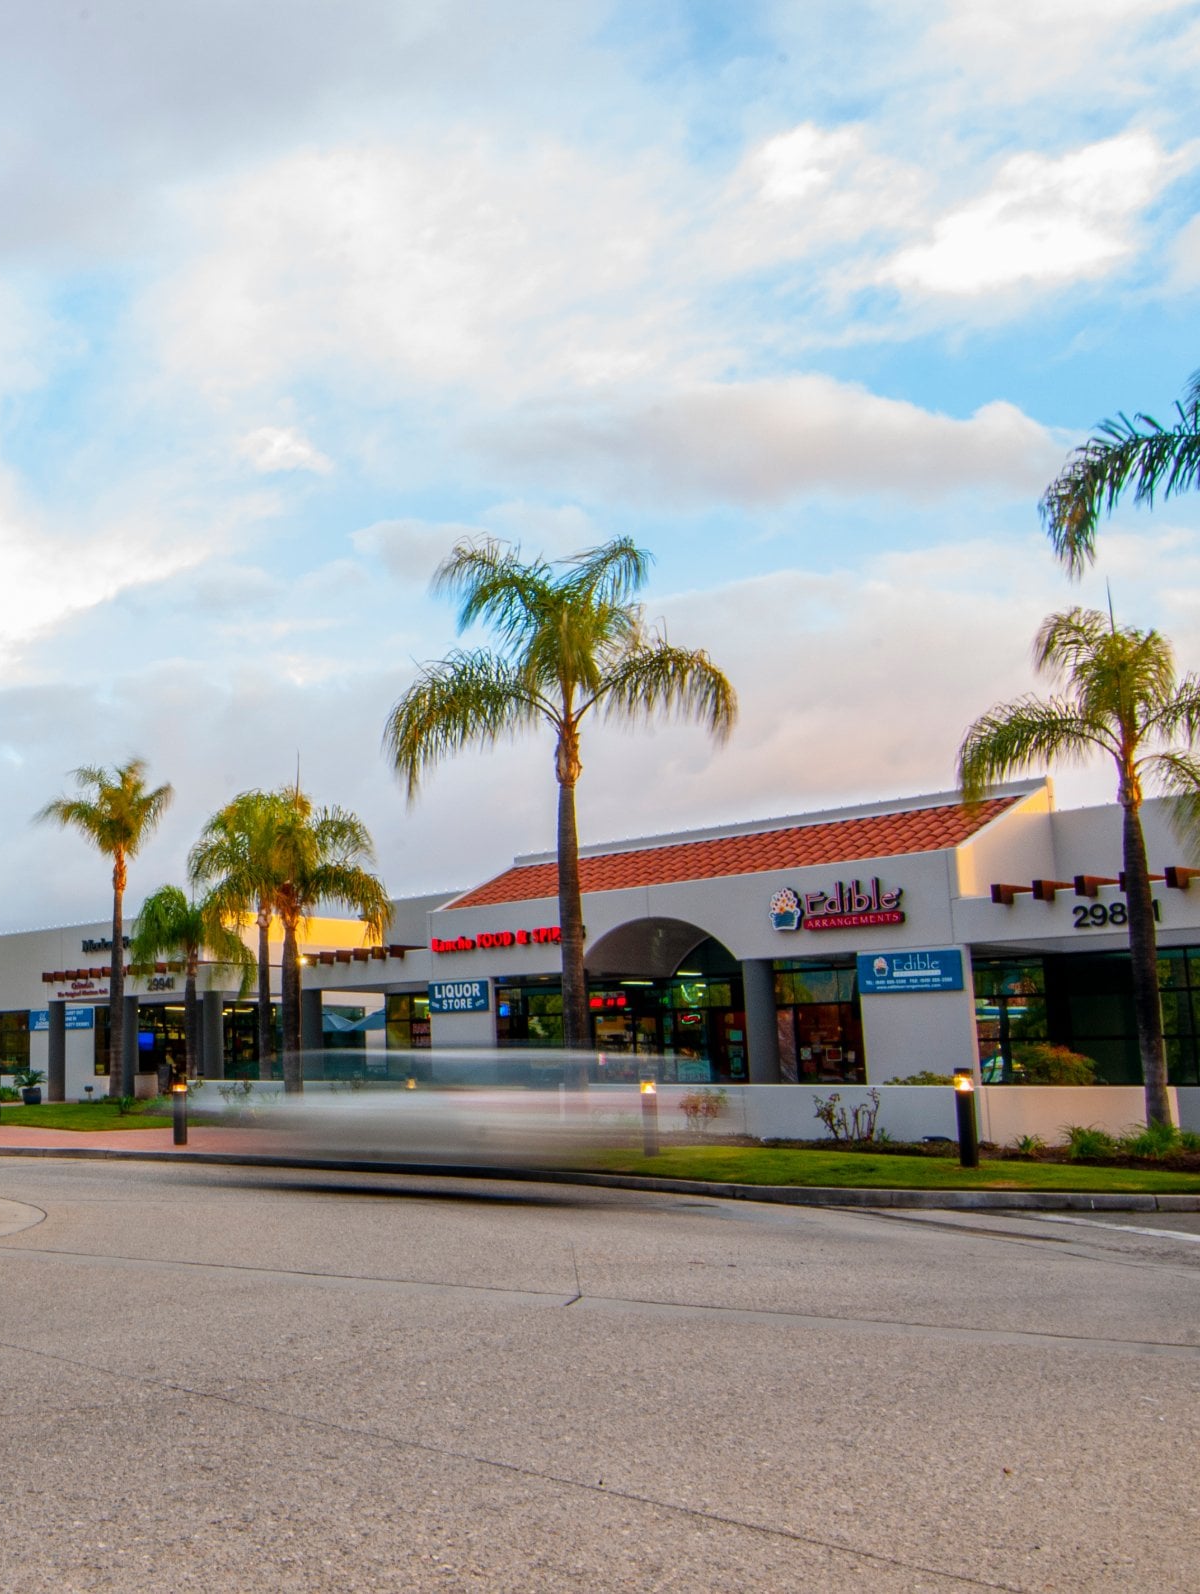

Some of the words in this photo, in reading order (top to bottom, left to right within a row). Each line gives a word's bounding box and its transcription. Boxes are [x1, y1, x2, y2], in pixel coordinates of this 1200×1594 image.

[805, 877, 899, 915] Edible
[807, 912, 900, 929] ARRANGEMENTS
[1072, 899, 1160, 928] 2981
[431, 936, 475, 952] Rancho
[476, 931, 514, 948] FOOD
[516, 929, 529, 945] &
[893, 953, 940, 971] Edible
[434, 983, 480, 999] LIQUOR
[442, 998, 473, 1010] STORE
